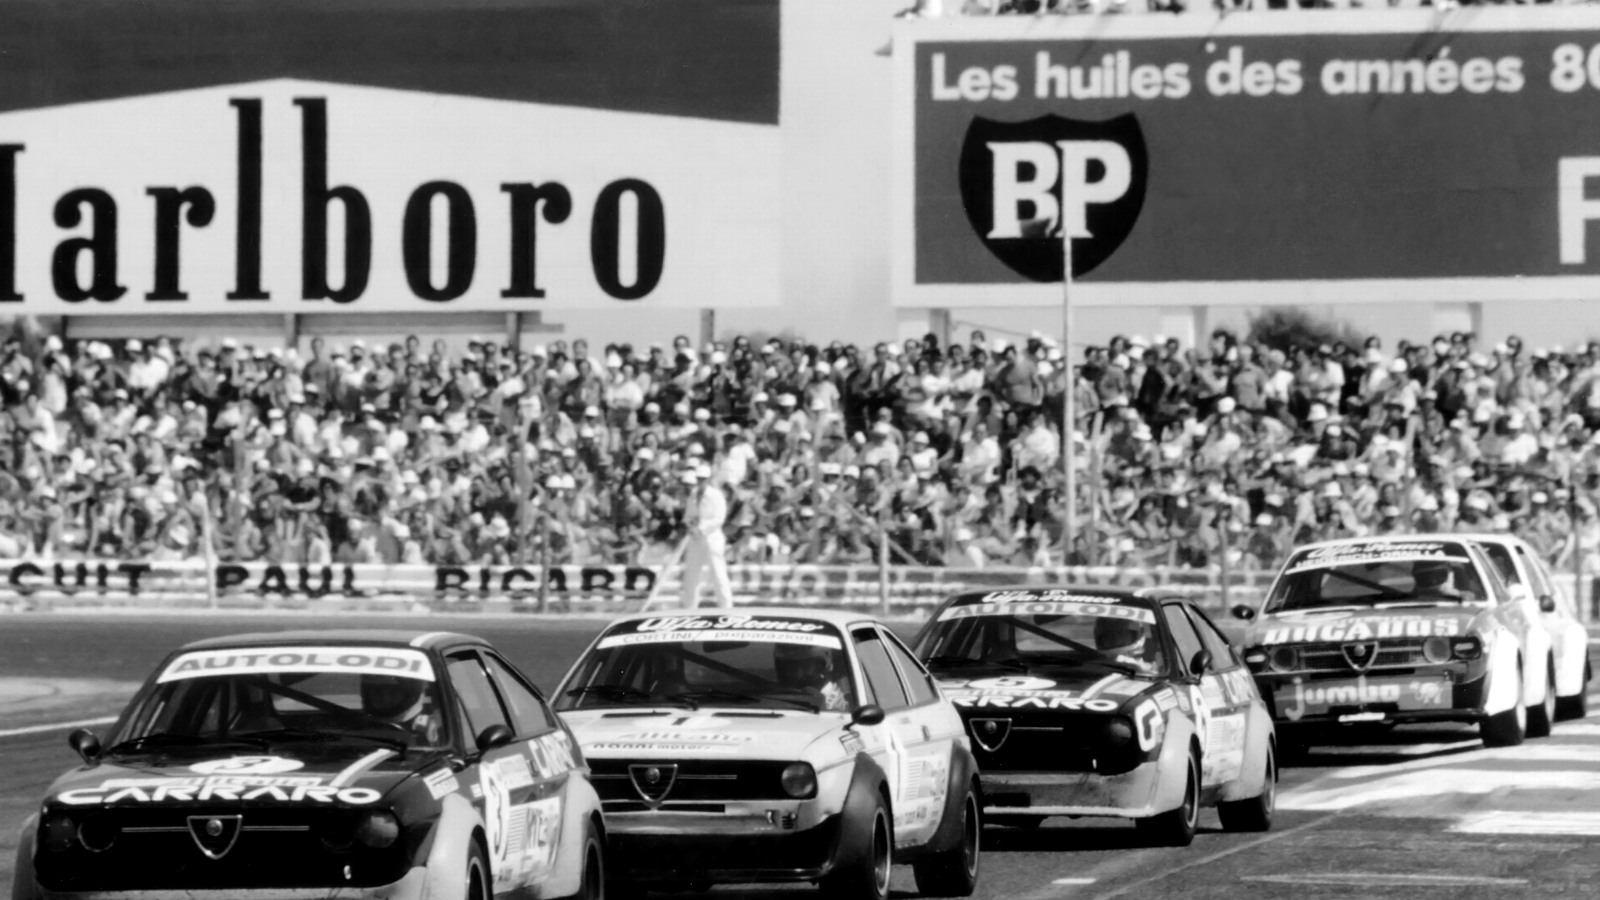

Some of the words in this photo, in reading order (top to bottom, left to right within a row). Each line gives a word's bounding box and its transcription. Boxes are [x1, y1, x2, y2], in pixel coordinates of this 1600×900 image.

[931, 52, 1019, 101] Les
[1035, 50, 1192, 99] huiles
[1205, 45, 1304, 97] des
[1319, 45, 1525, 95] années
[985, 139, 1132, 239] BP
[216, 564, 365, 598] PAUL
[636, 616, 712, 632] Alfa
[713, 616, 825, 632] Romeo
[951, 603, 1152, 621] AUTOLODI
[172, 653, 424, 674] AUTOLODI
[1284, 675, 1401, 722] jumbo
[57, 784, 382, 806] CARRARO
